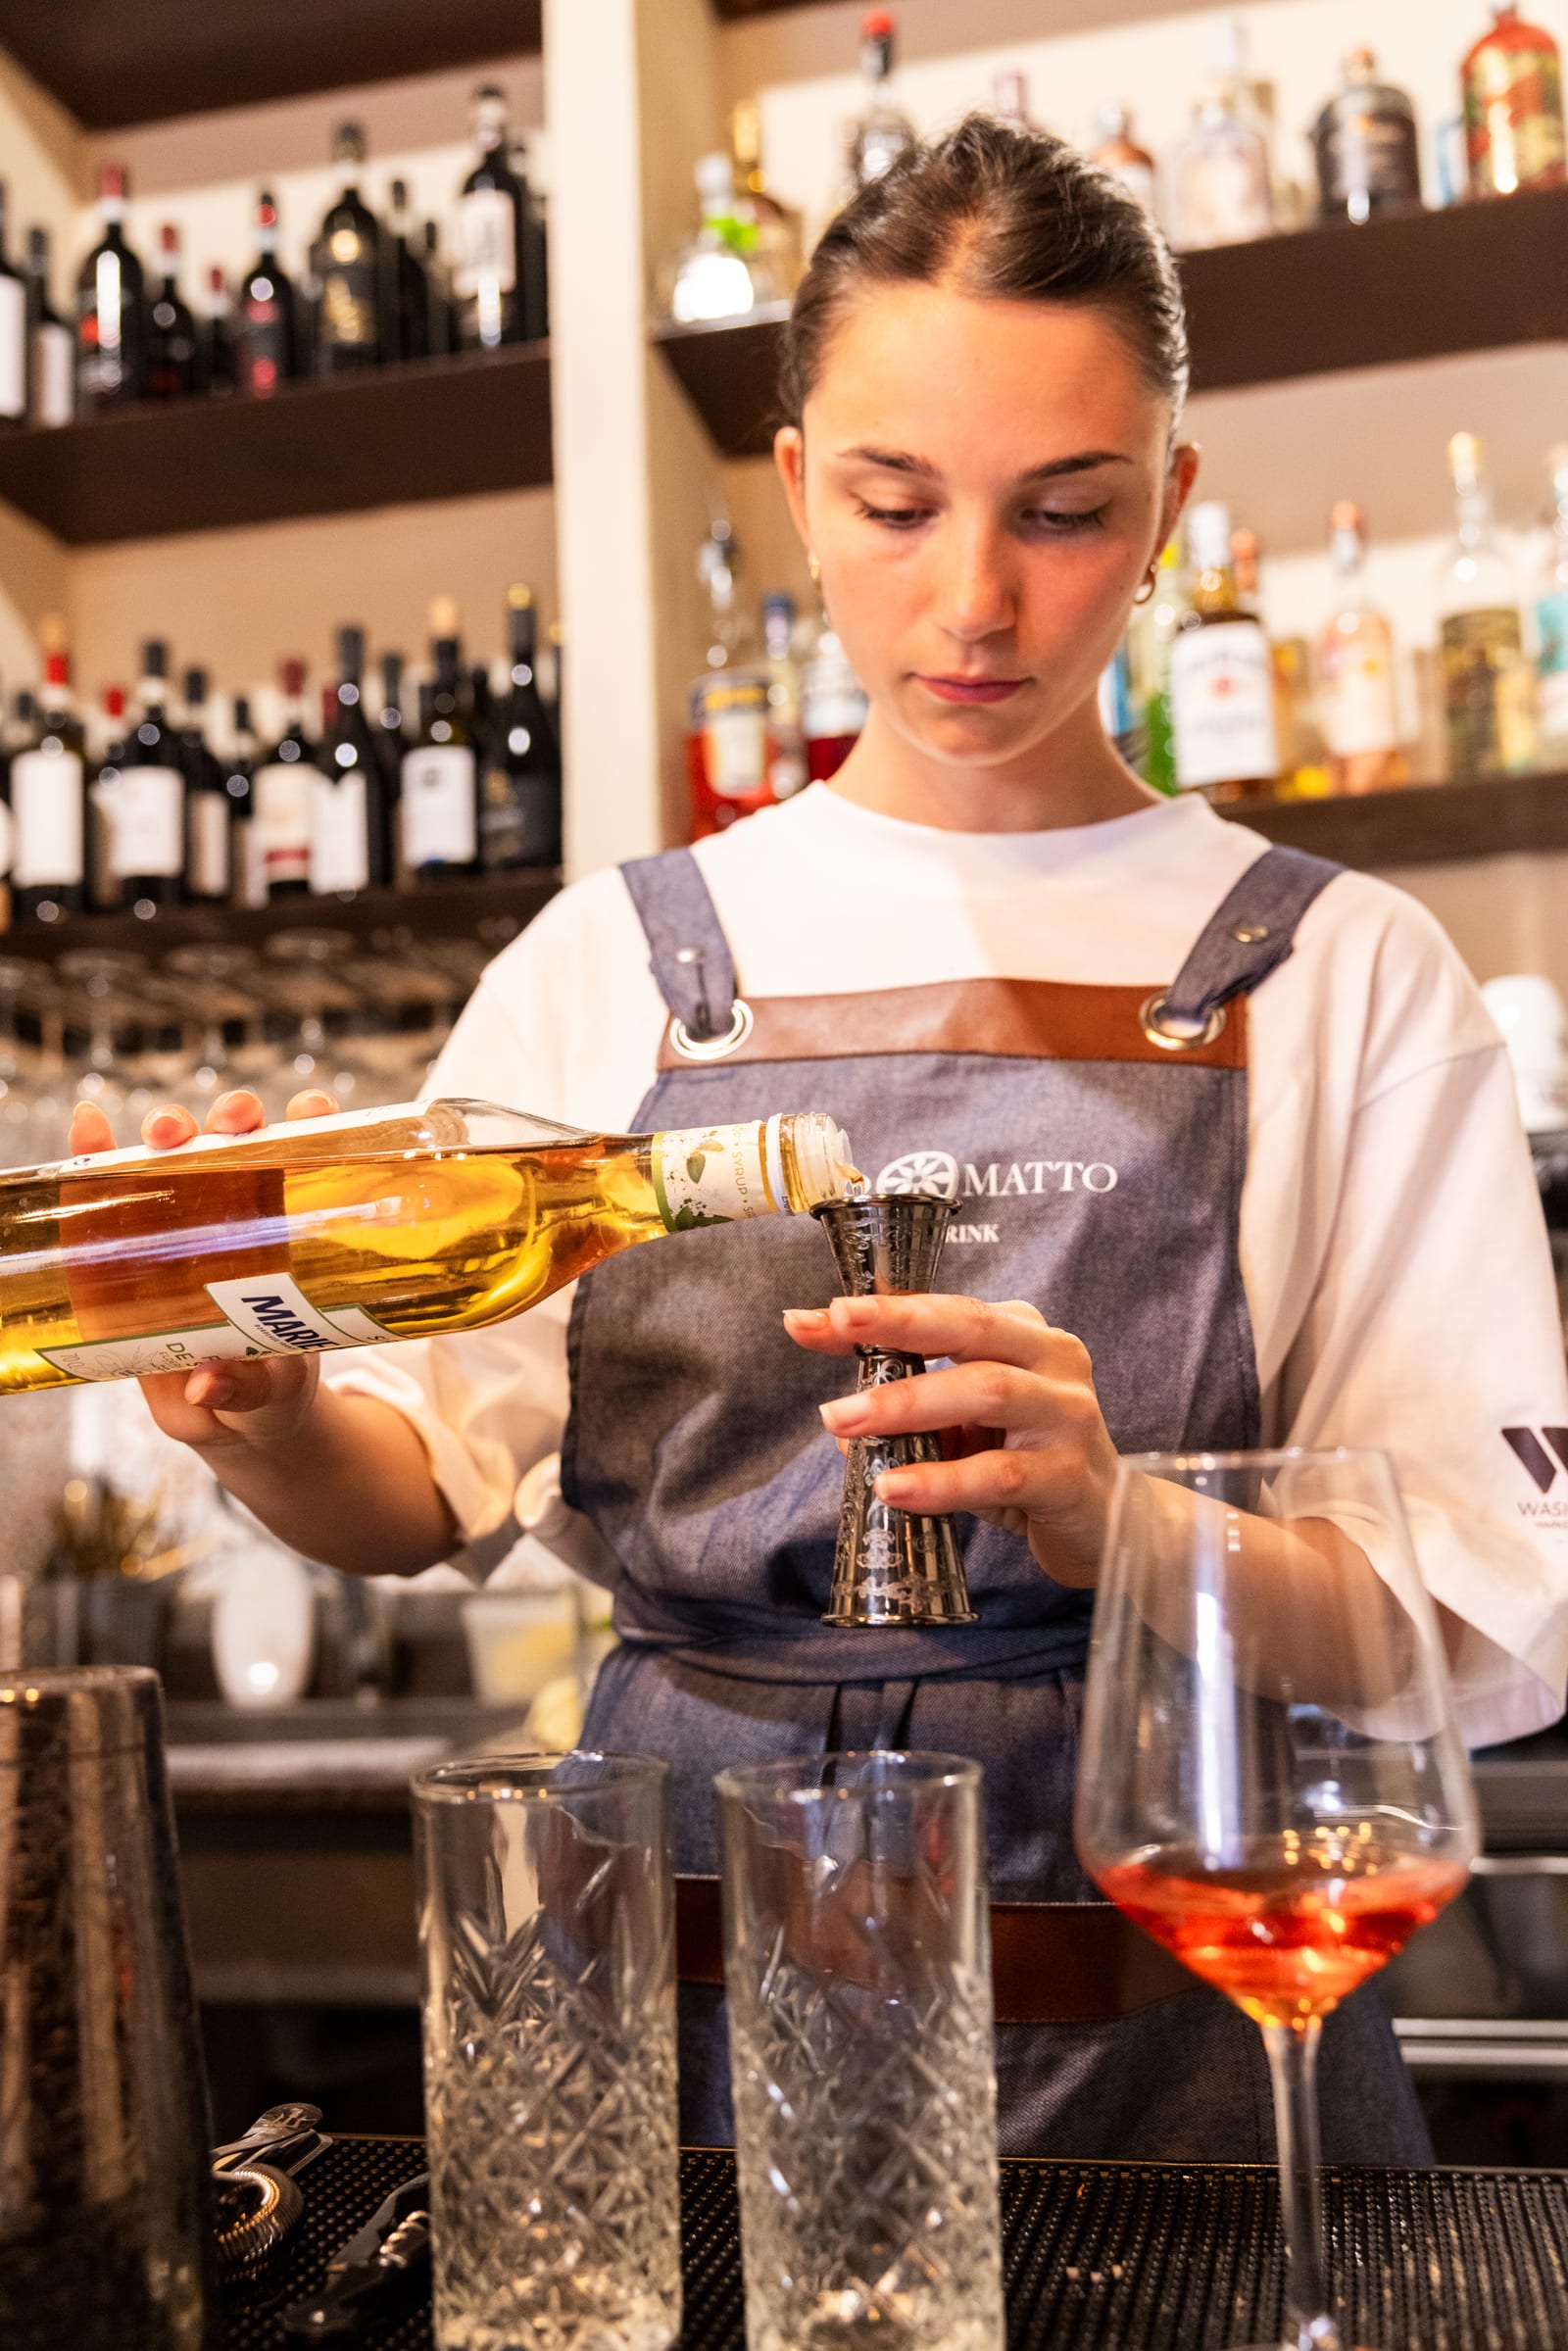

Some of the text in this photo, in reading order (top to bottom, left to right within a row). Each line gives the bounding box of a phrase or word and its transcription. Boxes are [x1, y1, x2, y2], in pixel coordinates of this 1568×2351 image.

[731, 1151, 749, 1197] SYRUP
[962, 1160, 1119, 1198] MATTO
[944, 1224, 1001, 1244] RINK
[240, 1295, 341, 1351] MARIE
